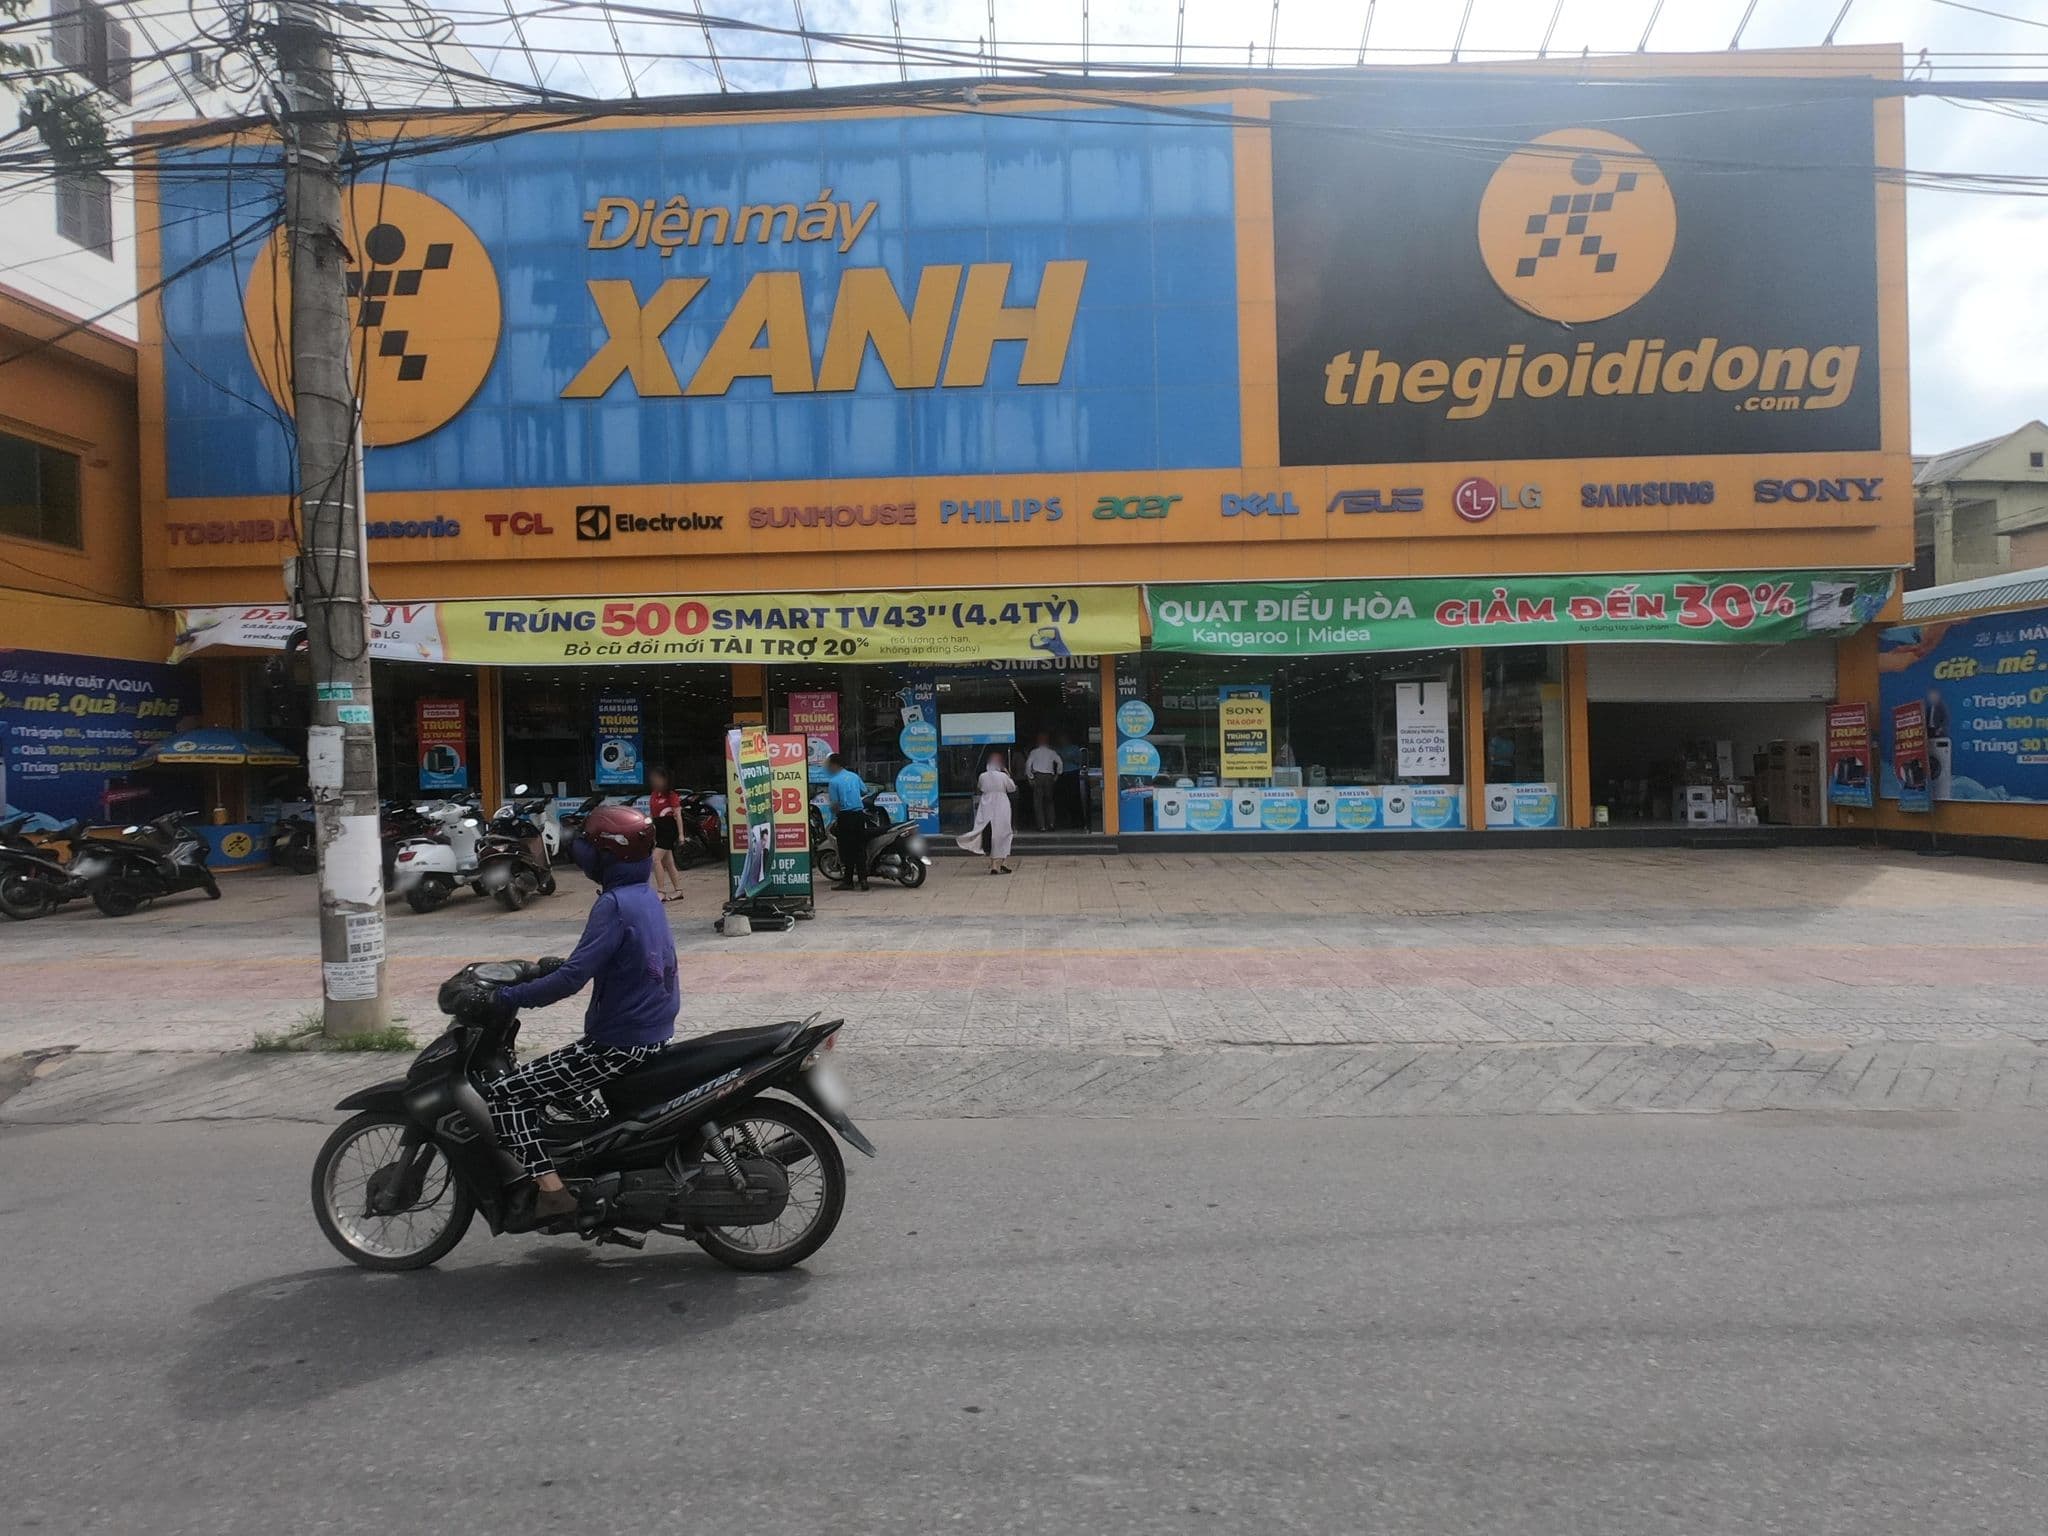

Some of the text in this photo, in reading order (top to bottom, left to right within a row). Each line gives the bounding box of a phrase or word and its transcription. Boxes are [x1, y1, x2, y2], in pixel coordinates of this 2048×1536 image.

[584, 187, 879, 257] Điện máy
[560, 260, 1087, 398] XANH
[1323, 338, 1861, 420] thegioididong
[1734, 394, 1801, 412] .com
[1326, 487, 1425, 514] ASUS
[1499, 484, 1543, 511] LG
[1581, 481, 1716, 508] SAMSUNG
[1754, 477, 1883, 504] SONY
[749, 501, 918, 529] SUNHOUSE
[939, 496, 1064, 524] PHILIPS
[1091, 493, 1183, 520] acer
[1220, 492, 1300, 517] DELL
[167, 518, 297, 546] TOSHIBA
[485, 511, 554, 539] TCL
[616, 512, 724, 535] Electrolux
[1159, 590, 1417, 628] QUẠT ĐIỀU HÒA
[1434, 582, 1796, 631] GIẢM ĐẾN 30%
[484, 608, 596, 633] TRÚNG
[601, 601, 710, 637] 500
[713, 607, 831, 631] SMART
[838, 606, 880, 629] TV
[384, 631, 400, 640] LG
[1192, 626, 1371, 647] Kangaroo Midea
[2019, 624, 2048, 642] MÁY
[563, 635, 870, 660] Bỏ cũ đổi mới TÀI TRỢ 20%
[992, 655, 1099, 671] SAMSUNG
[44, 674, 74, 687] MÁY
[75, 676, 106, 692] GIẶT
[106, 679, 155, 693] AQUA
[1119, 687, 1137, 696] TIVI
[812, 701, 825, 709] LG
[1226, 707, 1264, 715] SONY
[422, 719, 463, 731] TRÚNG
[599, 714, 639, 726] TRÚNG
[793, 711, 835, 724] TRÚNG
[1972, 716, 2003, 731] Quà
[1251, 730, 1263, 740] 70
[782, 743, 802, 758] 70
[1418, 745, 1424, 754] 6
[1972, 738, 2018, 755] Trúng
[21, 762, 59, 774] Trúng
[777, 771, 802, 781] DATA
[787, 872, 810, 885] GAME
[658, 1066, 742, 1115] JUPITER
